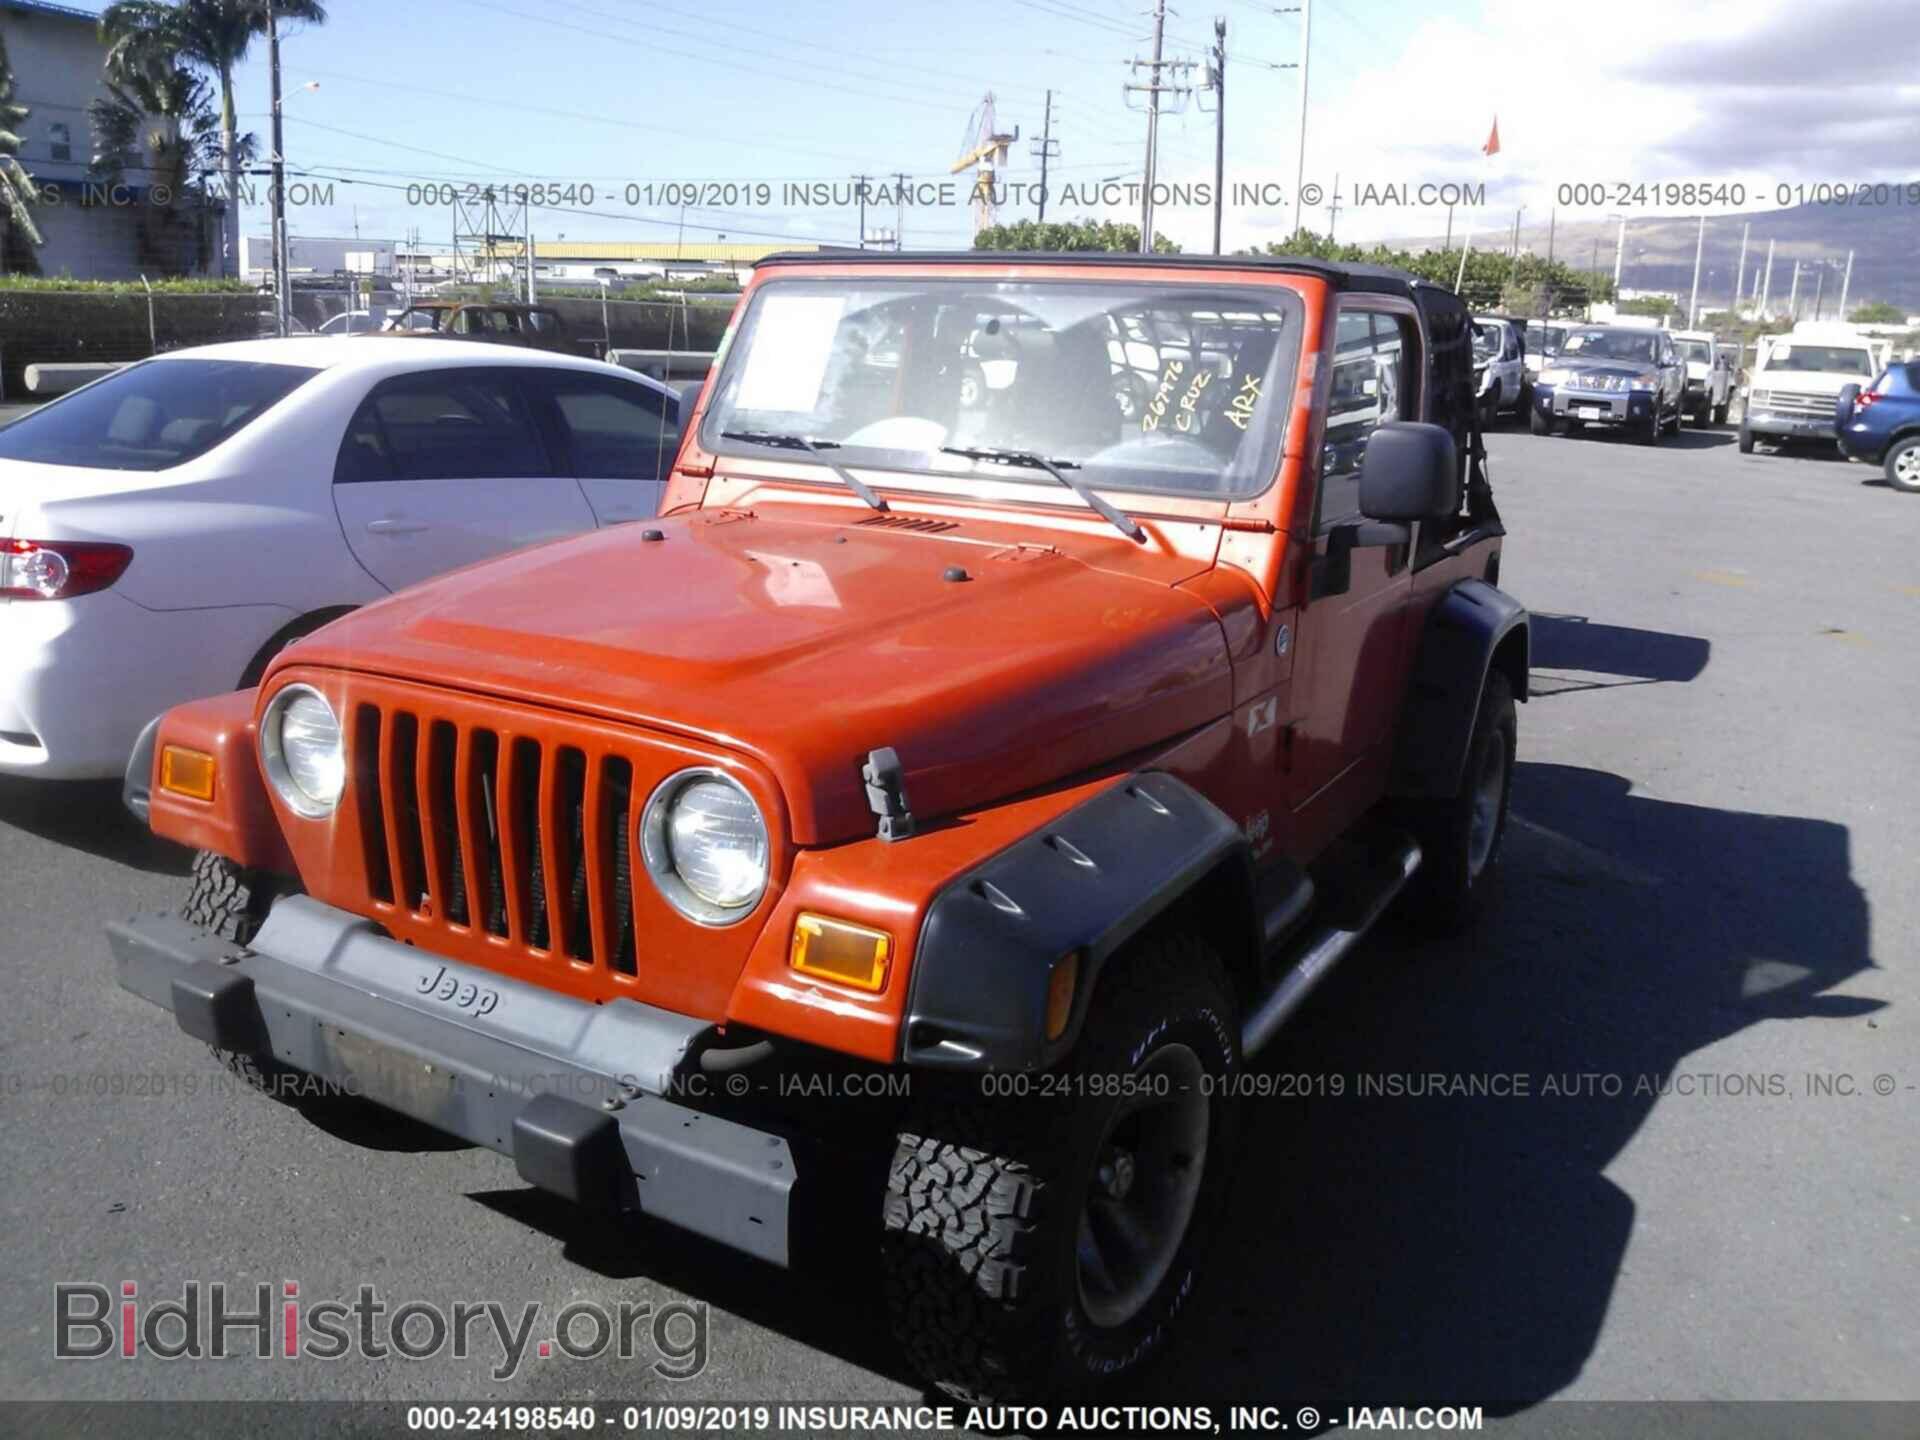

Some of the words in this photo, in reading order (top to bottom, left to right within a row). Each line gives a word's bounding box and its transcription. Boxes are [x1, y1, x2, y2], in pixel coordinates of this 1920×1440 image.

[1175, 370, 1212, 432] CRUZ
[1223, 374, 1264, 430] ARX
[417, 966, 499, 1018] Jeep
